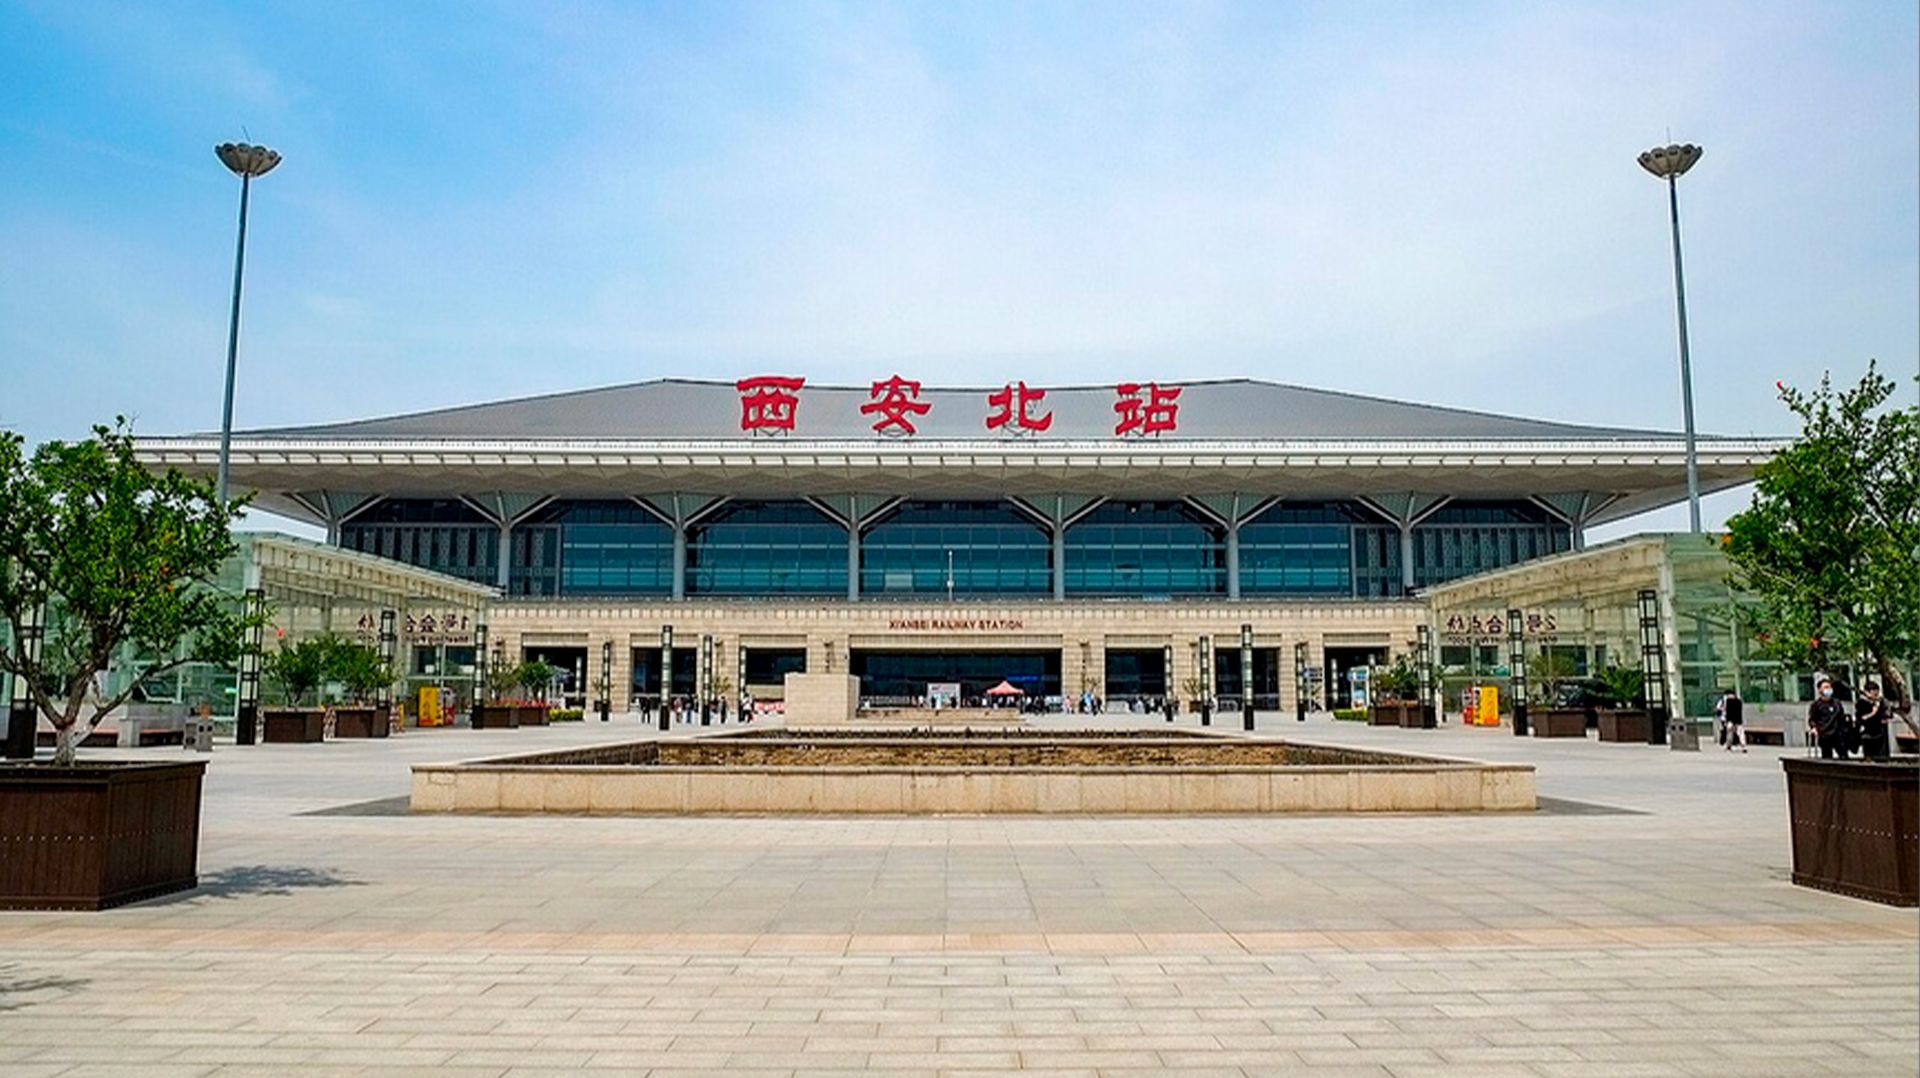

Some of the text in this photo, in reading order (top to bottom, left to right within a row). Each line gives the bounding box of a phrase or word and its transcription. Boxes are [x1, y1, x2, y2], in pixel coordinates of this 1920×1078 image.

[736, 374, 1182, 436] 西安北站
[889, 619, 1023, 631] XIANBEI RAILWAY STATION
